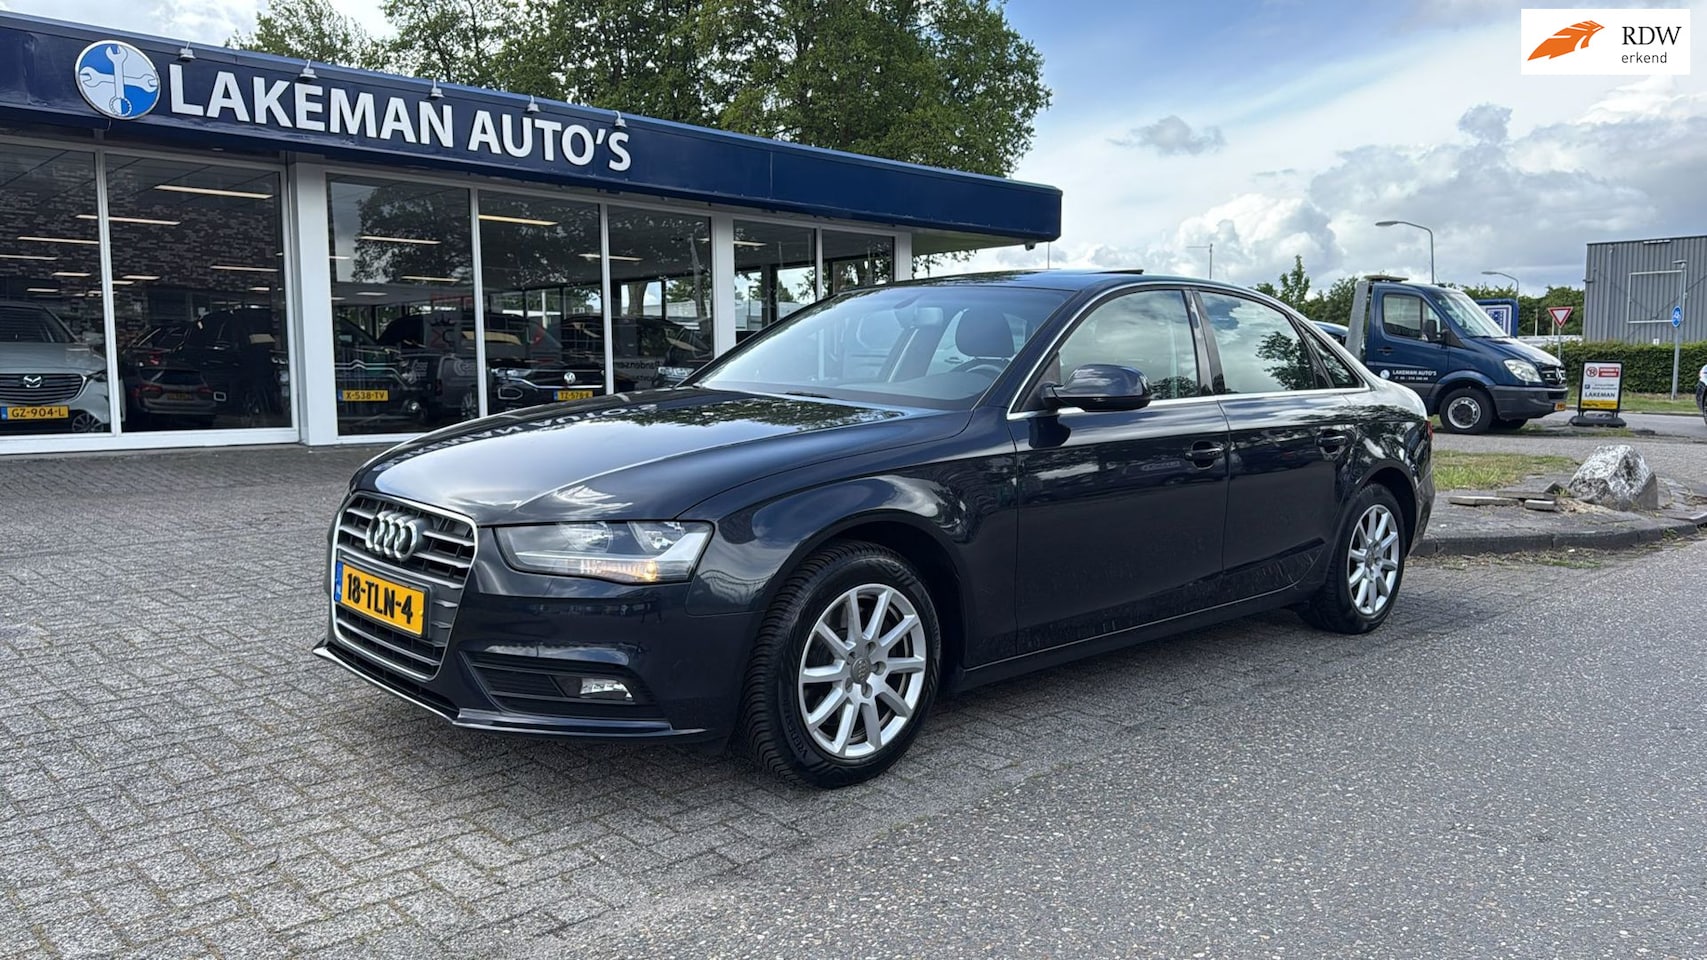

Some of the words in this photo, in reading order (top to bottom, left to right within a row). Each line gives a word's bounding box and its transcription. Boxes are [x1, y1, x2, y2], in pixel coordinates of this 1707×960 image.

[169, 63, 454, 149] LAKEMAN
[467, 110, 632, 173] AUTO'S
[345, 391, 385, 400] X-538-TV
[11, 407, 65, 418] GZ-904-L
[346, 573, 414, 625] 18-TLN-4
